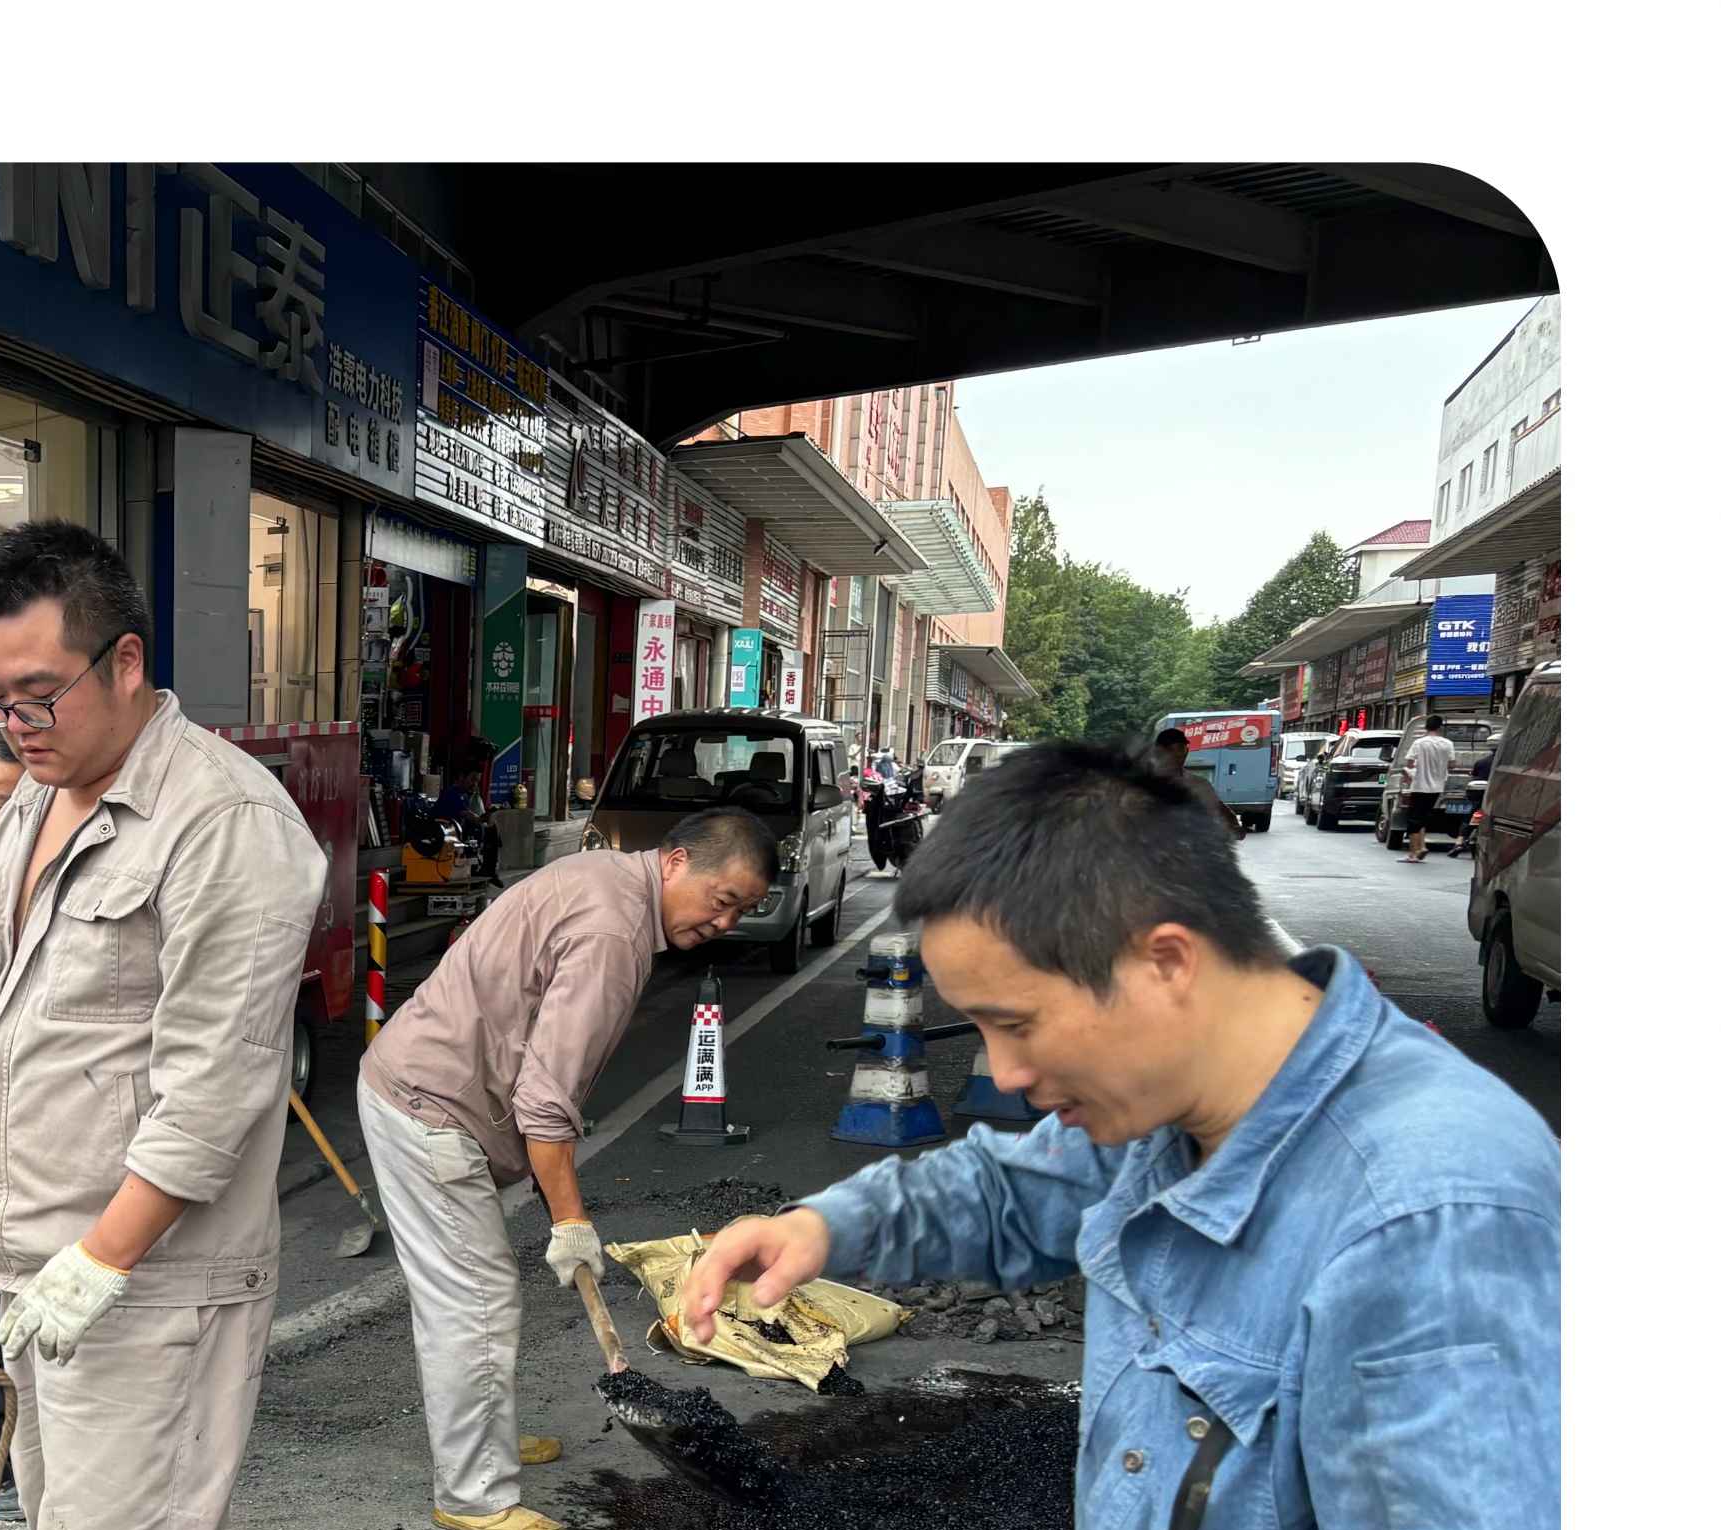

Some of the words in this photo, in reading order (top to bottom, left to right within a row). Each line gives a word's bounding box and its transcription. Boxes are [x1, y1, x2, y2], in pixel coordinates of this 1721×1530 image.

[328, 341, 403, 426] 浩霖电力科技
[1437, 619, 1477, 631] GTK
[695, 1029, 717, 1083] 运满满
[694, 1083, 715, 1092] APP
